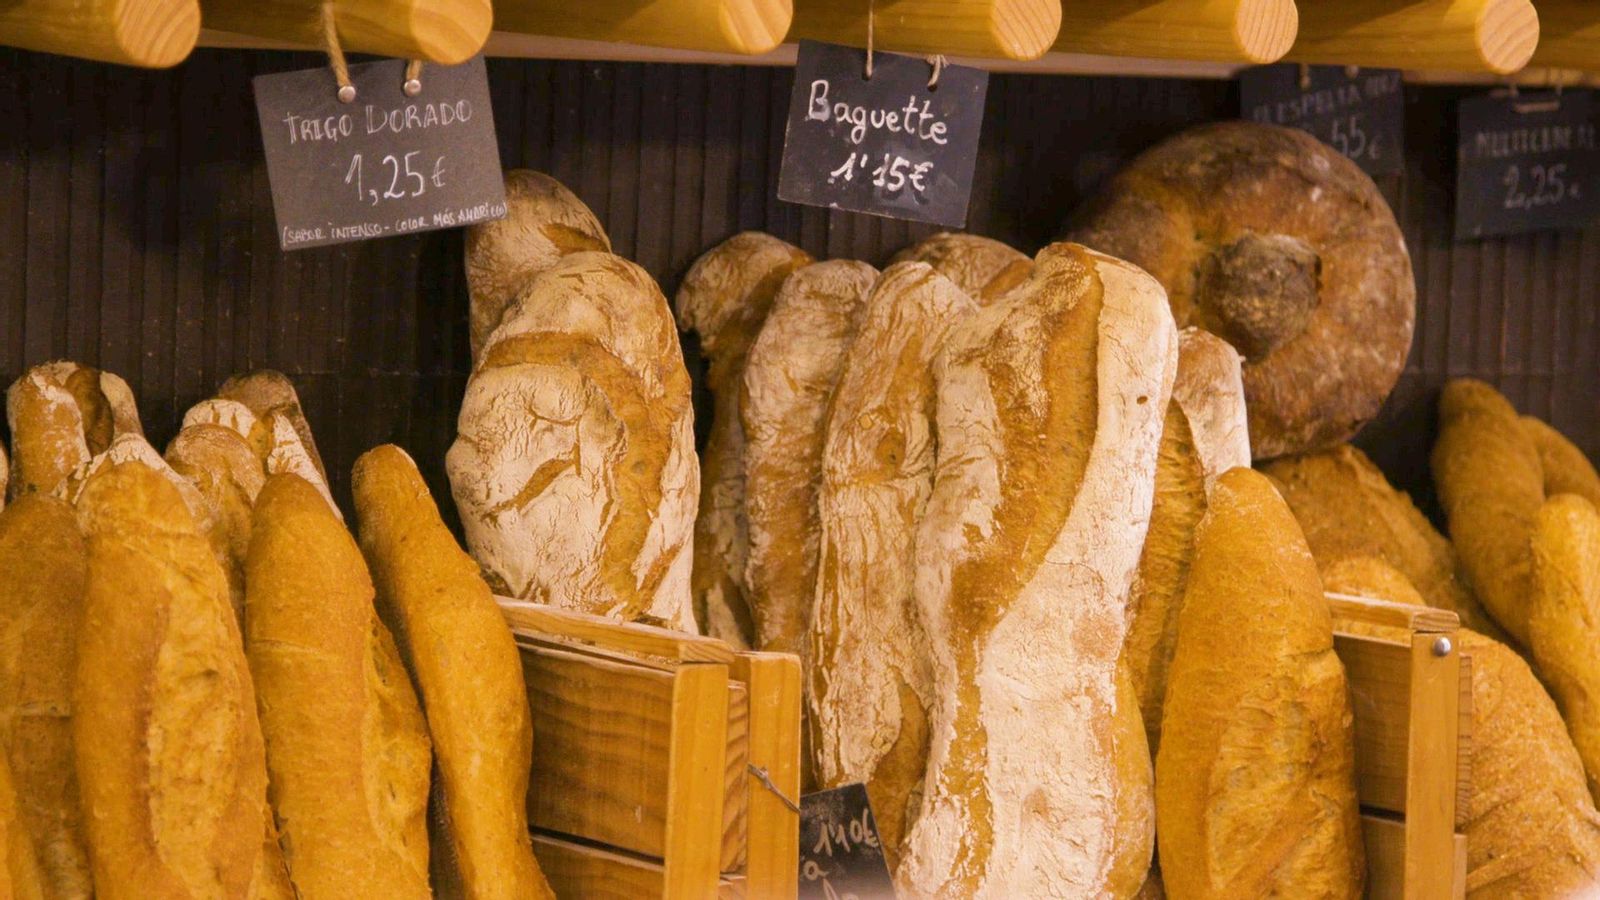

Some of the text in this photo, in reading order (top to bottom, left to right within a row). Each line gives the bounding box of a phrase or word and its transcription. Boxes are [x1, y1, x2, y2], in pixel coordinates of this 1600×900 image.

[283, 99, 472, 145] TRIGO DORADO
[808, 79, 948, 145] Baguette
[344, 151, 446, 206] 1,25€
[395, 216, 429, 232] COLOR
